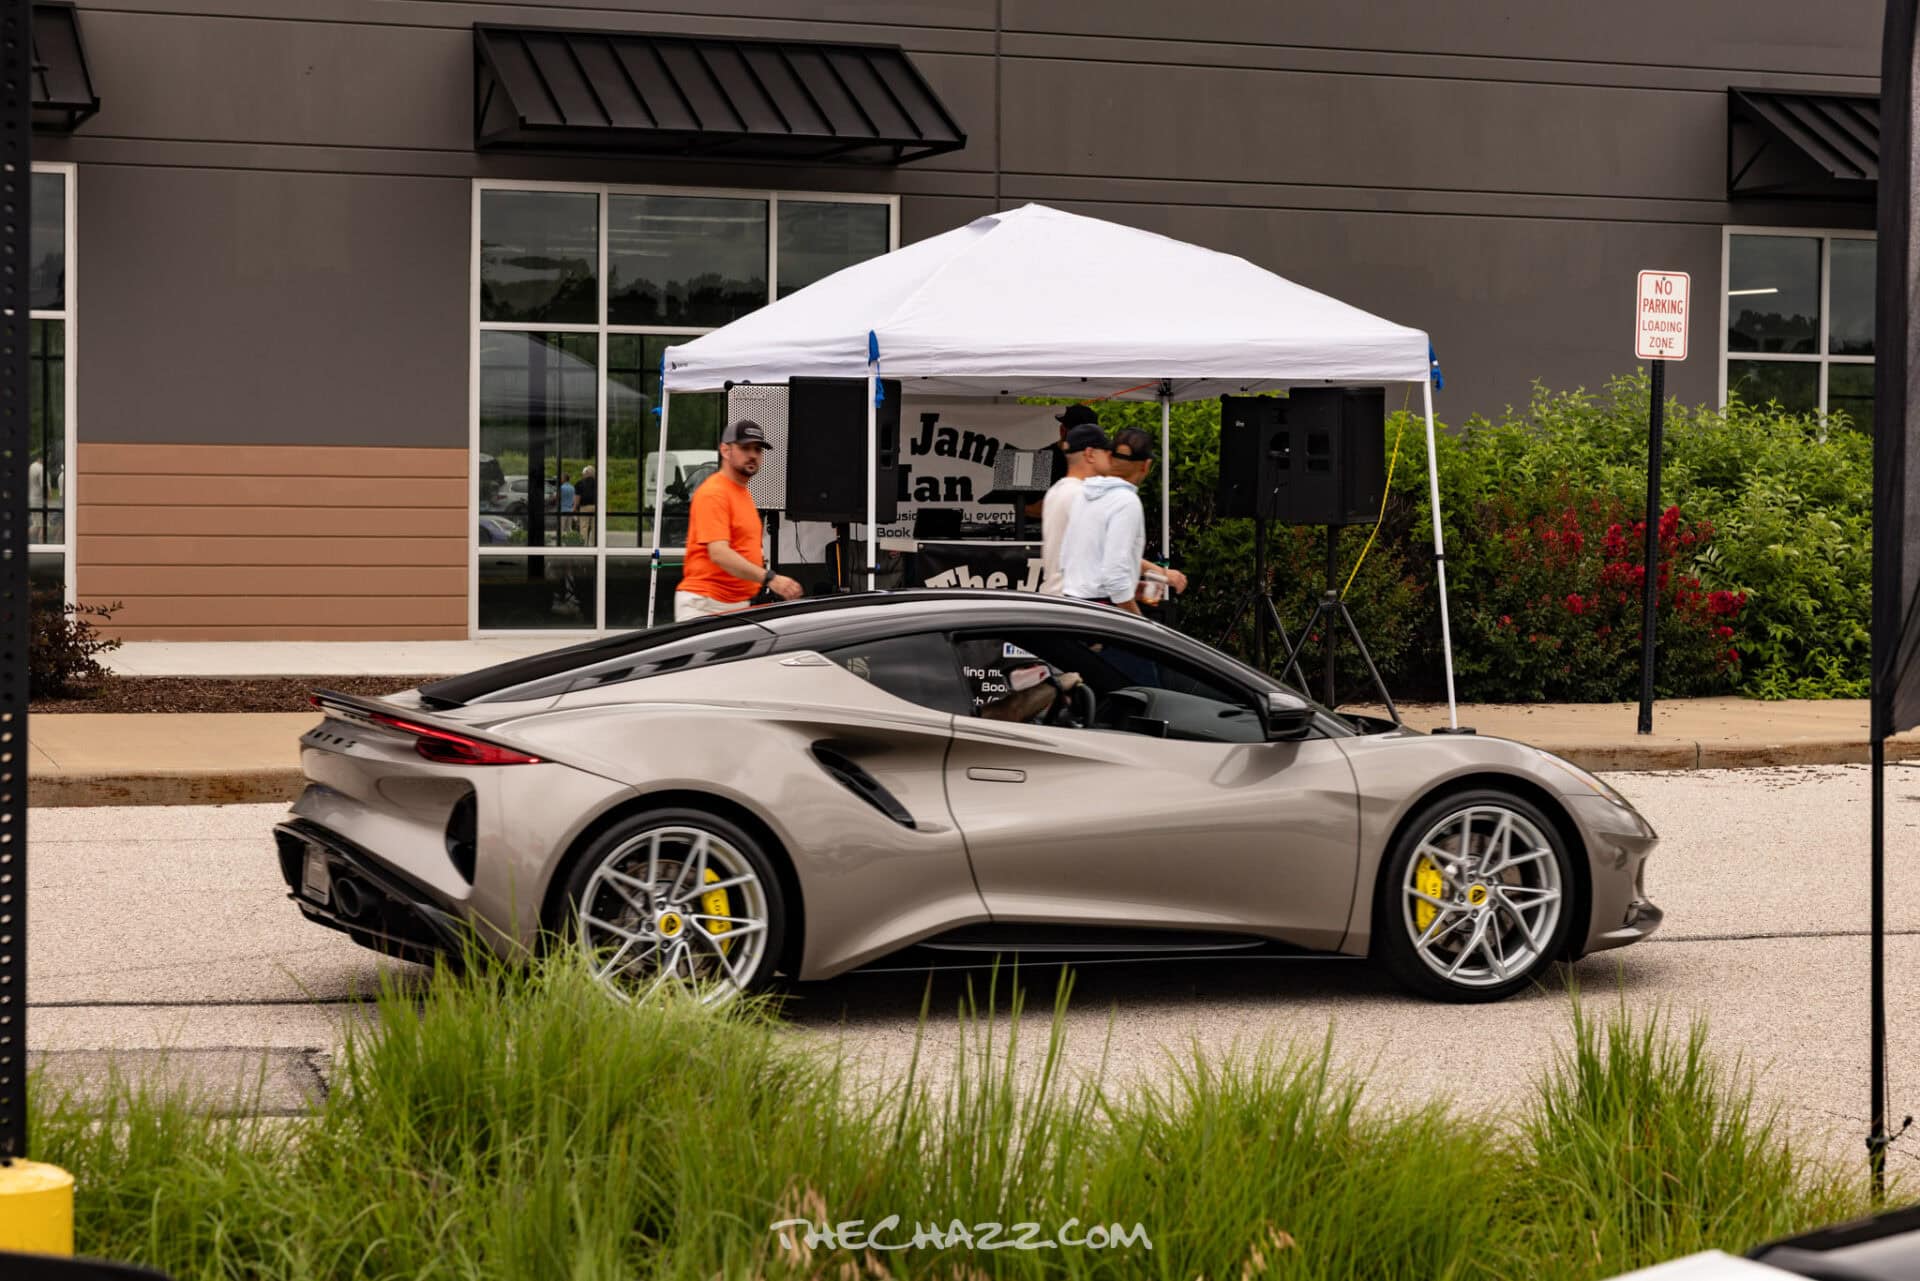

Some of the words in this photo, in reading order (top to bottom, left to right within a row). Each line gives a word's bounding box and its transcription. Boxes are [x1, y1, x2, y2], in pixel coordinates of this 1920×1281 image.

[1655, 280, 1673, 295] NO
[1642, 298, 1683, 314] PARKING
[1642, 320, 1682, 333] LOADING
[1649, 336, 1674, 349] ZONE
[910, 413, 999, 468] Jam
[876, 527, 911, 538] Book
[924, 564, 1009, 590] The
[981, 682, 1008, 693] Boo
